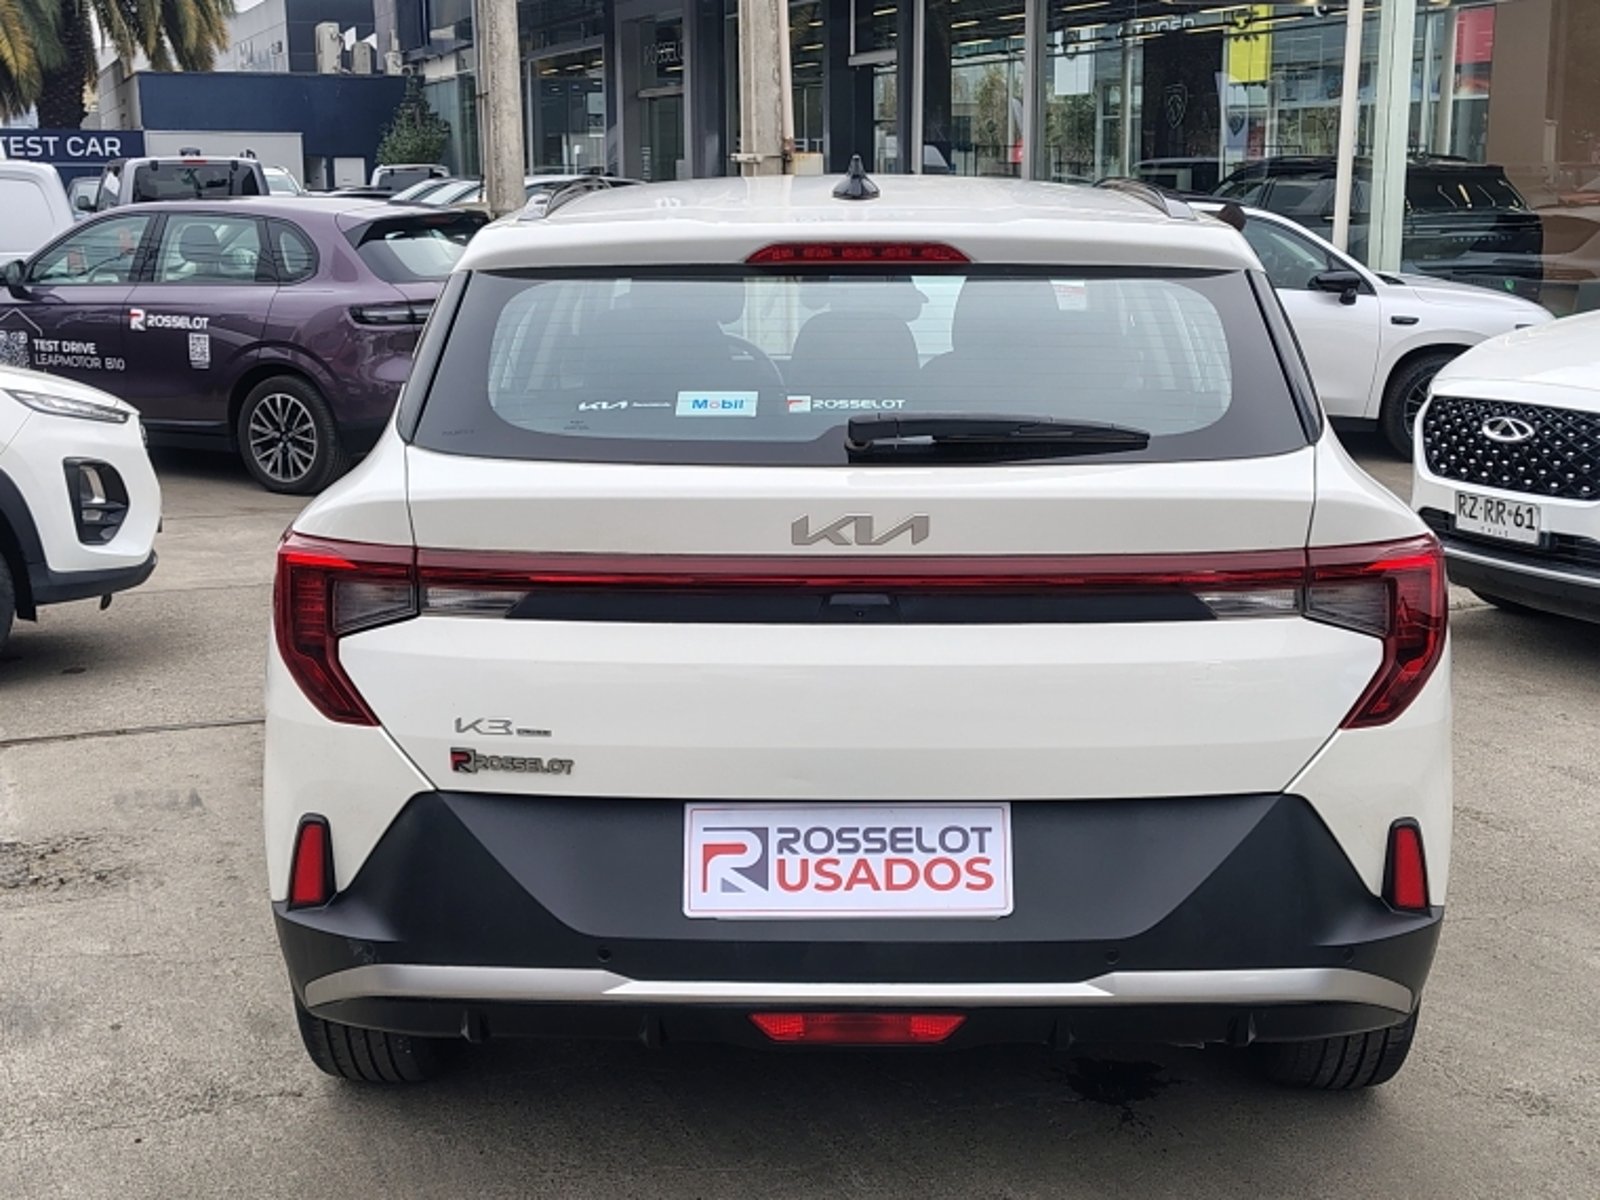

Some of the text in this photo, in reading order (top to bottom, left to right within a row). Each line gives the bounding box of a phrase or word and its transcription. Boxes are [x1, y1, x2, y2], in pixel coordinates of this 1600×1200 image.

[0, 136, 121, 157] EST CAR
[147, 315, 209, 330] ROSSELOT
[33, 339, 97, 354] TEST DRIVE
[35, 354, 101, 369] LEAPMOTOR
[691, 399, 744, 410] Mobil
[812, 399, 906, 409] ROSSELOT
[791, 512, 929, 546] KIA
[455, 717, 513, 735] K3
[476, 754, 575, 775] ROSSELOT
[776, 826, 992, 855] ROSSELOT
[776, 857, 994, 892] USADOS
